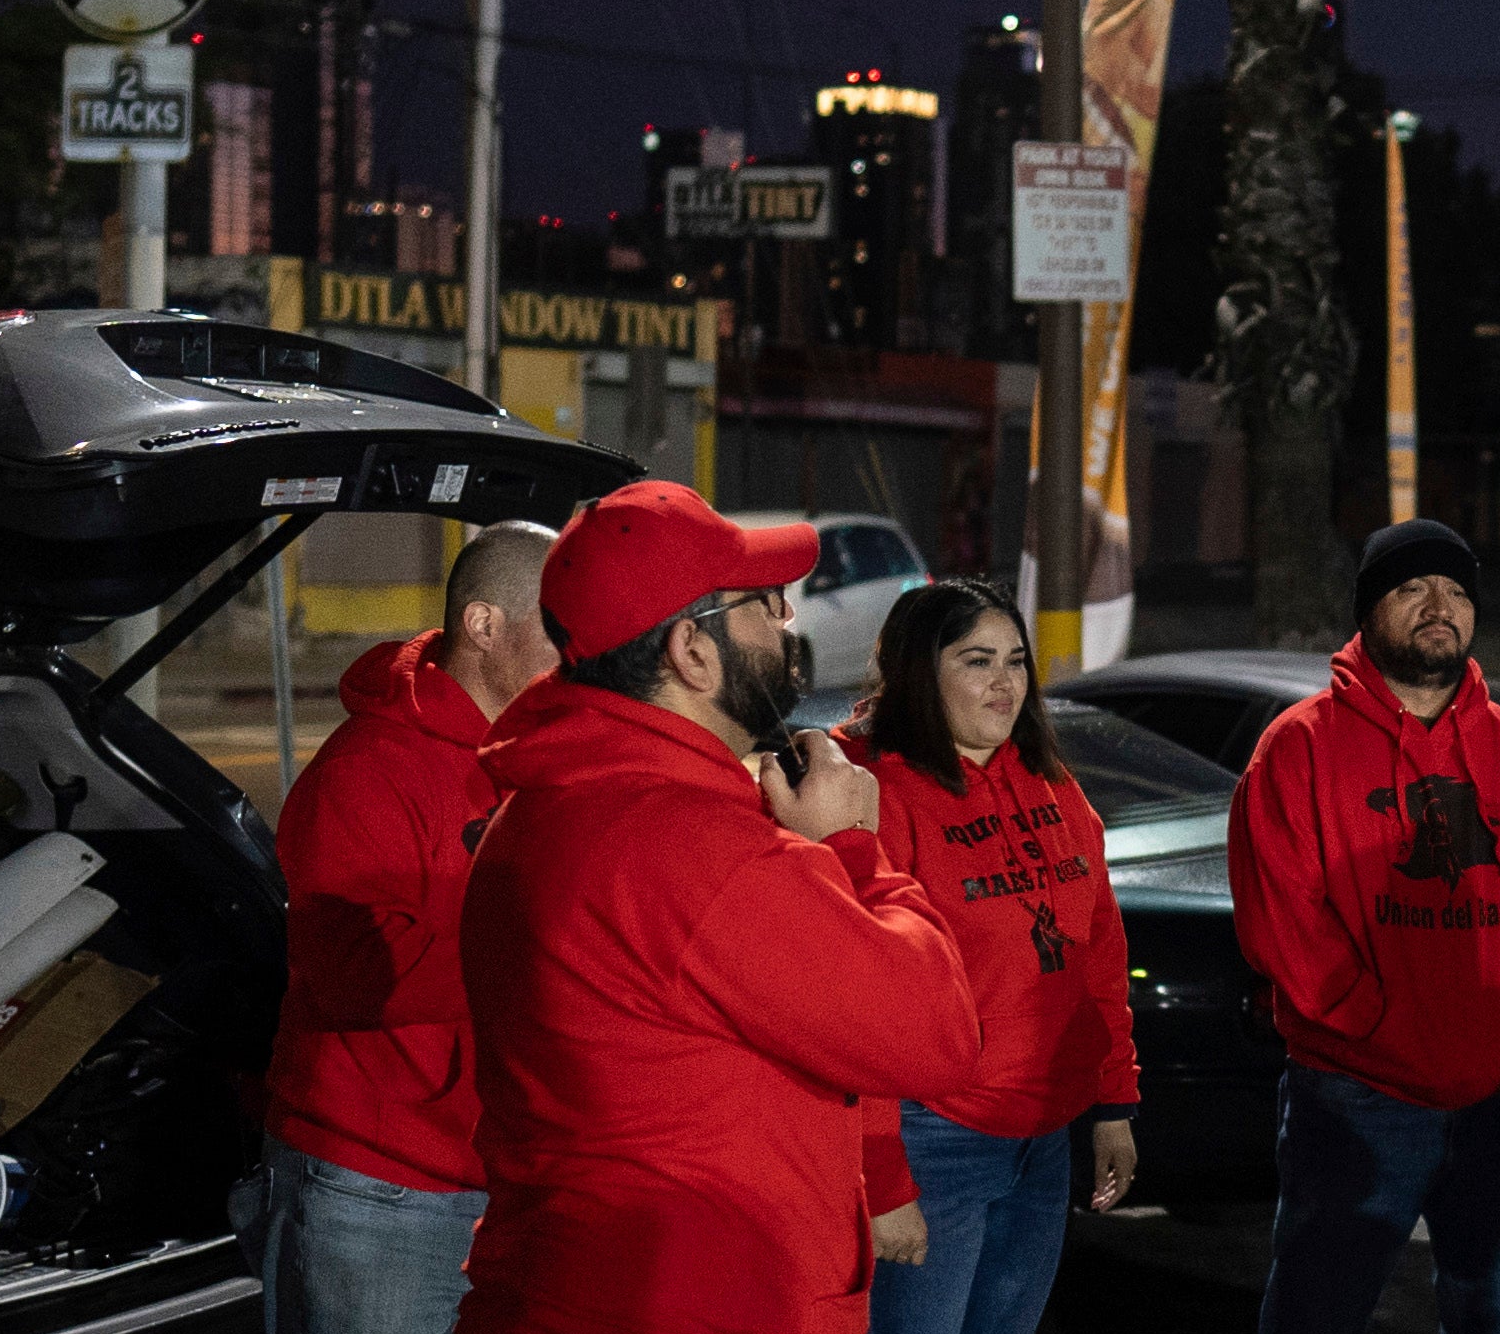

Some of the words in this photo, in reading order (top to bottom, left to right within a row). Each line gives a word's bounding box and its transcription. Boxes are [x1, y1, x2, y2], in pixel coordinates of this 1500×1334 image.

[118, 68, 139, 100] 2
[77, 100, 181, 134] TRACKS
[319, 271, 431, 329] DTLA
[437, 282, 607, 342] WNDOW
[611, 300, 695, 348] TINT
